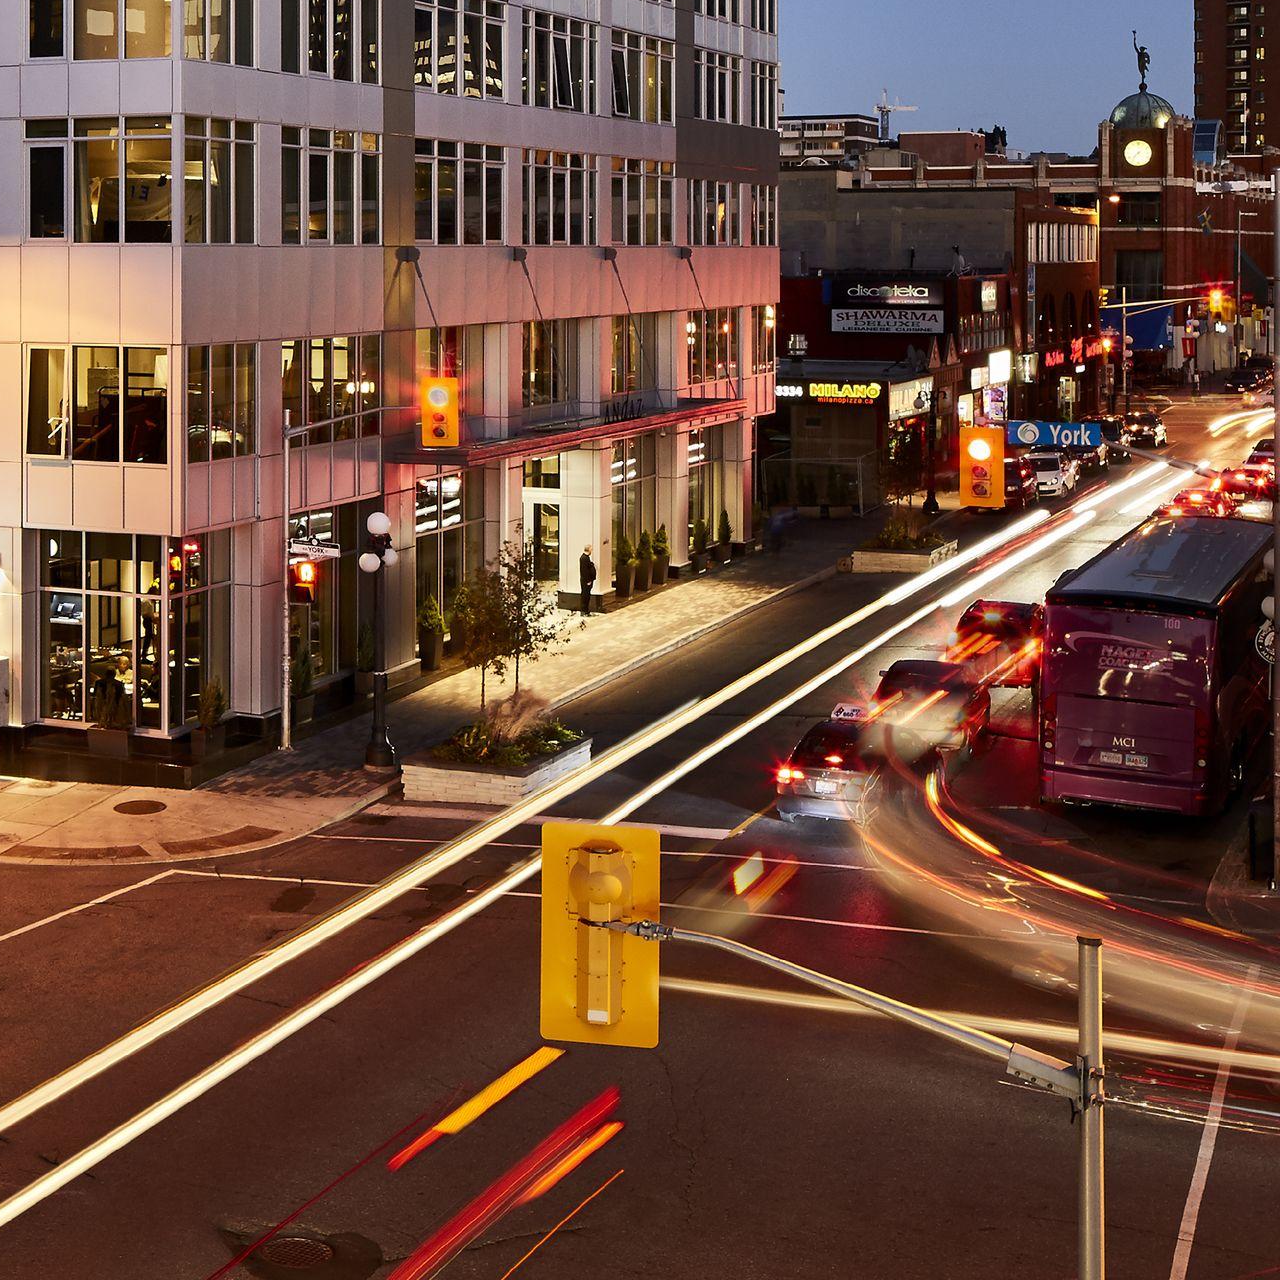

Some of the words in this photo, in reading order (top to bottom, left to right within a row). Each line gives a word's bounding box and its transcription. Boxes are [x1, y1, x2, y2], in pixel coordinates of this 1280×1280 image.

[836, 310, 939, 323] SHAWARMA
[809, 382, 881, 398] MILANO
[817, 397, 874, 405] milanopizza.ca
[1049, 424, 1091, 446] York
[307, 546, 325, 554] YORK
[1112, 736, 1135, 747] MCI
